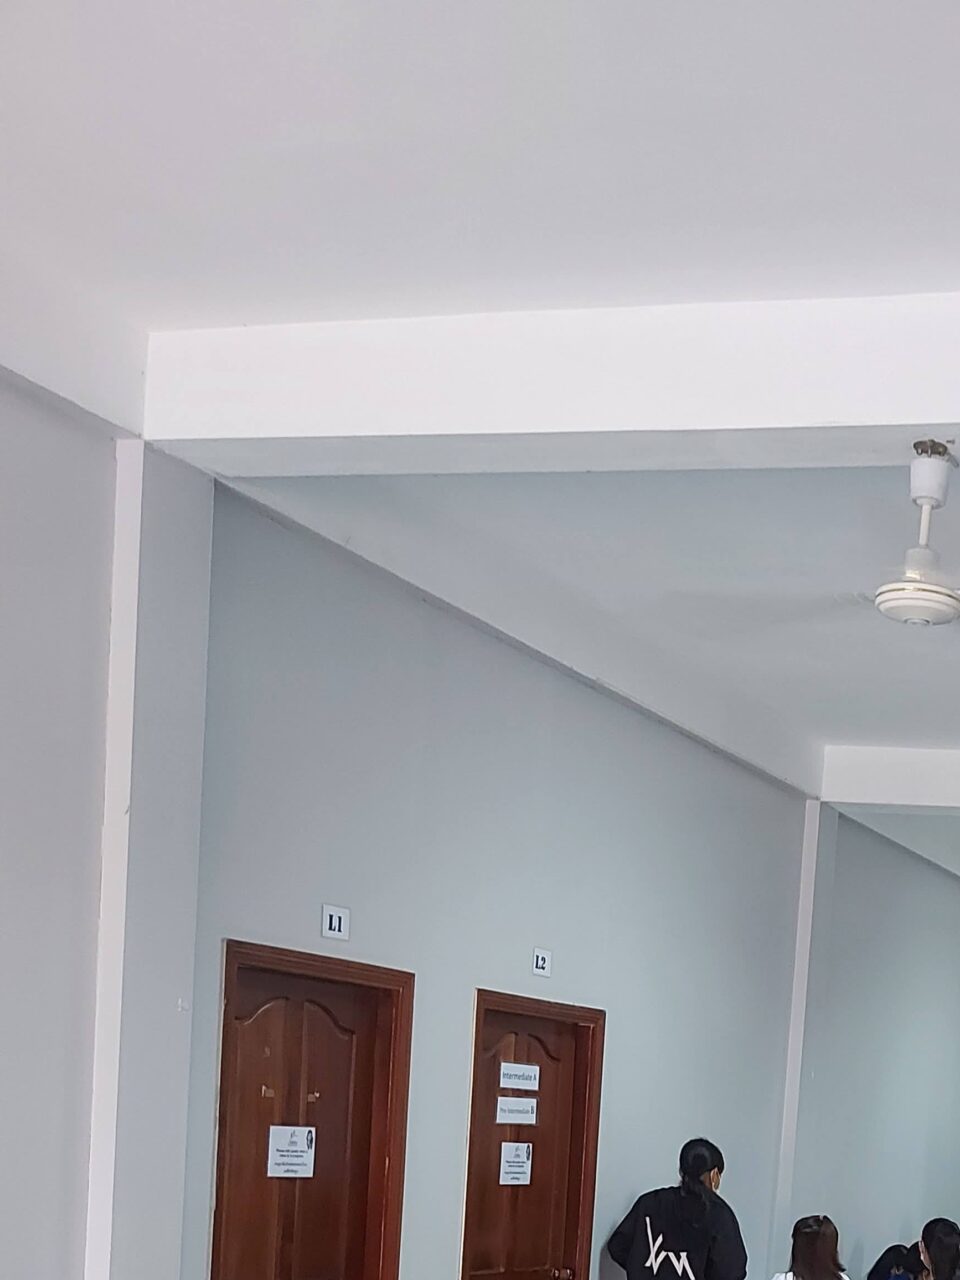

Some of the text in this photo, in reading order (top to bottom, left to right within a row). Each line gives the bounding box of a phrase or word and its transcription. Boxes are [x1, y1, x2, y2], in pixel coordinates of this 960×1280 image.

[328, 913, 343, 933] L1
[535, 954, 546, 971] L2
[502, 1070, 533, 1082] Intermediate
